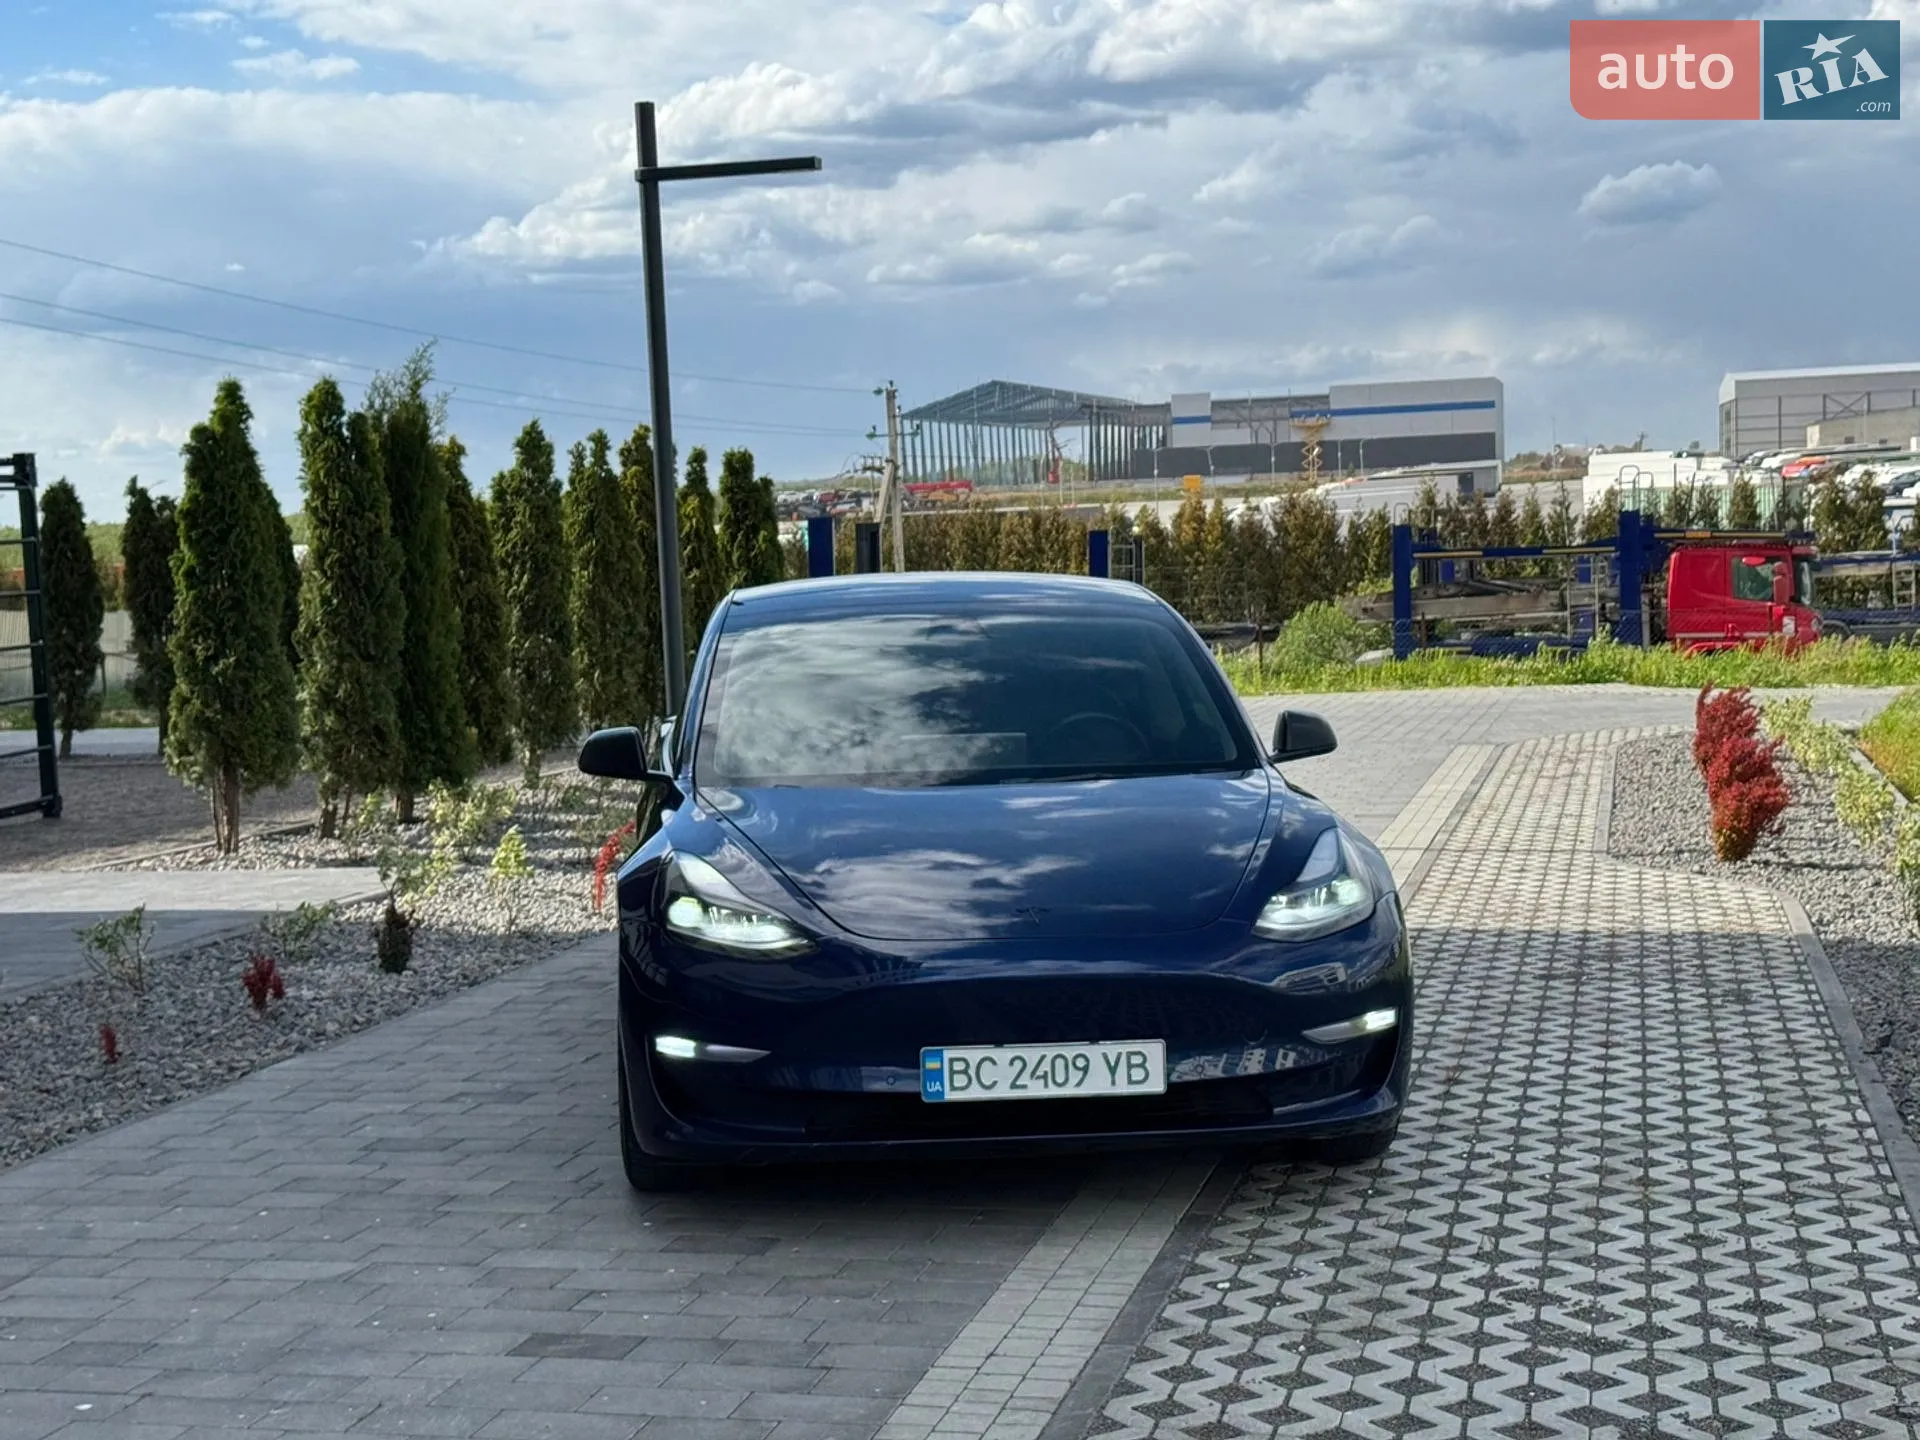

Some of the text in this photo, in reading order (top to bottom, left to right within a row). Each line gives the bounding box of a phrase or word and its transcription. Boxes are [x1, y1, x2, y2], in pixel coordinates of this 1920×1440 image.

[949, 1050, 1150, 1091] BC 2409 YB
[926, 1081, 943, 1093] UA
